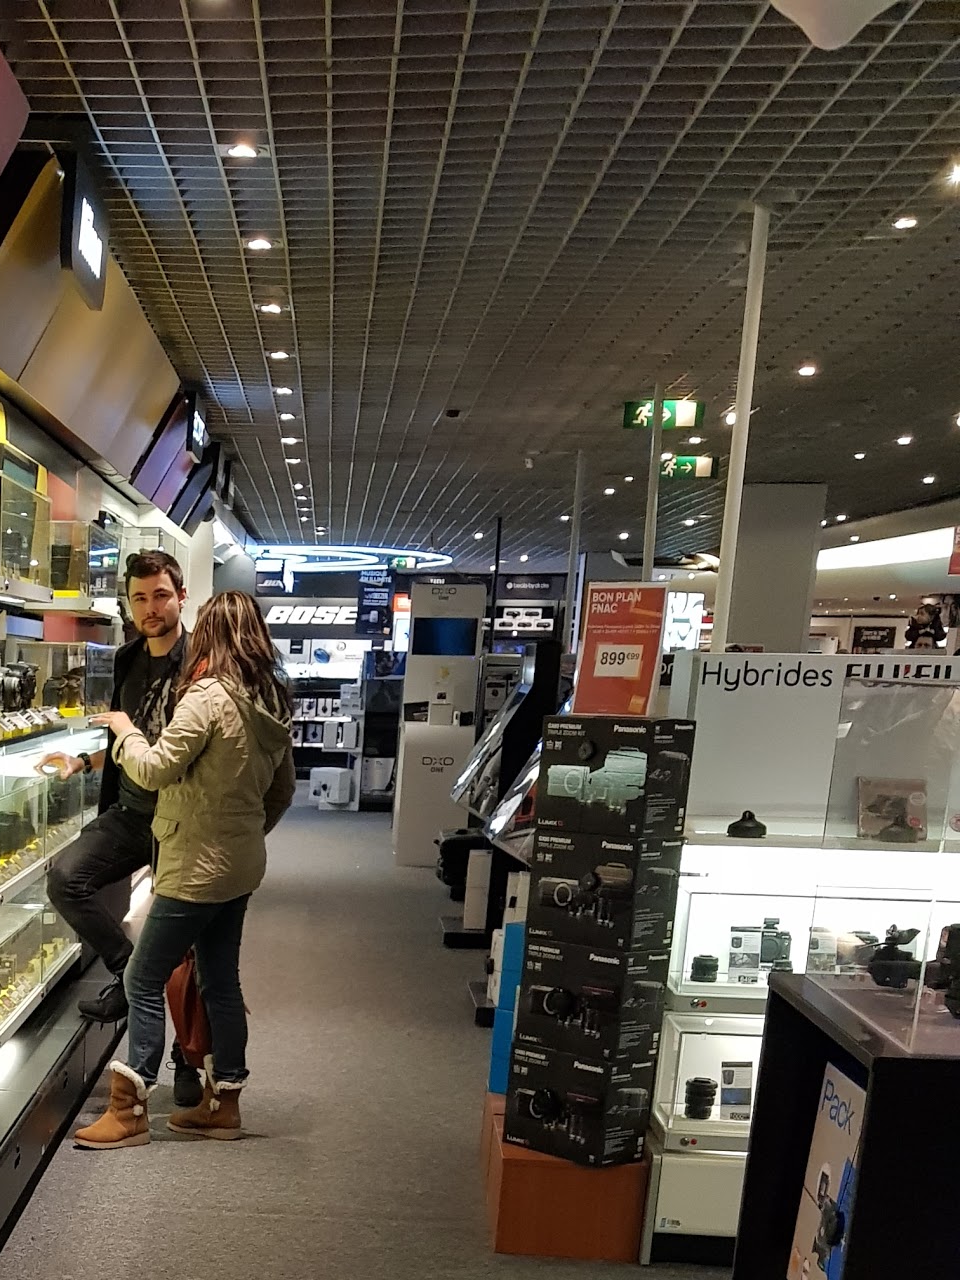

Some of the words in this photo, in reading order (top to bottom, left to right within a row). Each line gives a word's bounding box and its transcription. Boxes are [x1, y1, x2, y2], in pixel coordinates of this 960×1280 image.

[592, 592, 614, 602] BON
[616, 591, 641, 602] PLAN
[591, 603, 618, 613] FNAC
[266, 606, 358, 624] BOSE
[702, 661, 833, 691] Hybrides
[614, 725, 646, 734] Panasonic
[602, 841, 633, 851] Panasonic
[590, 954, 620, 965] Panasonic
[574, 1061, 604, 1074] Panasonic
[821, 1079, 855, 1135] Pack
